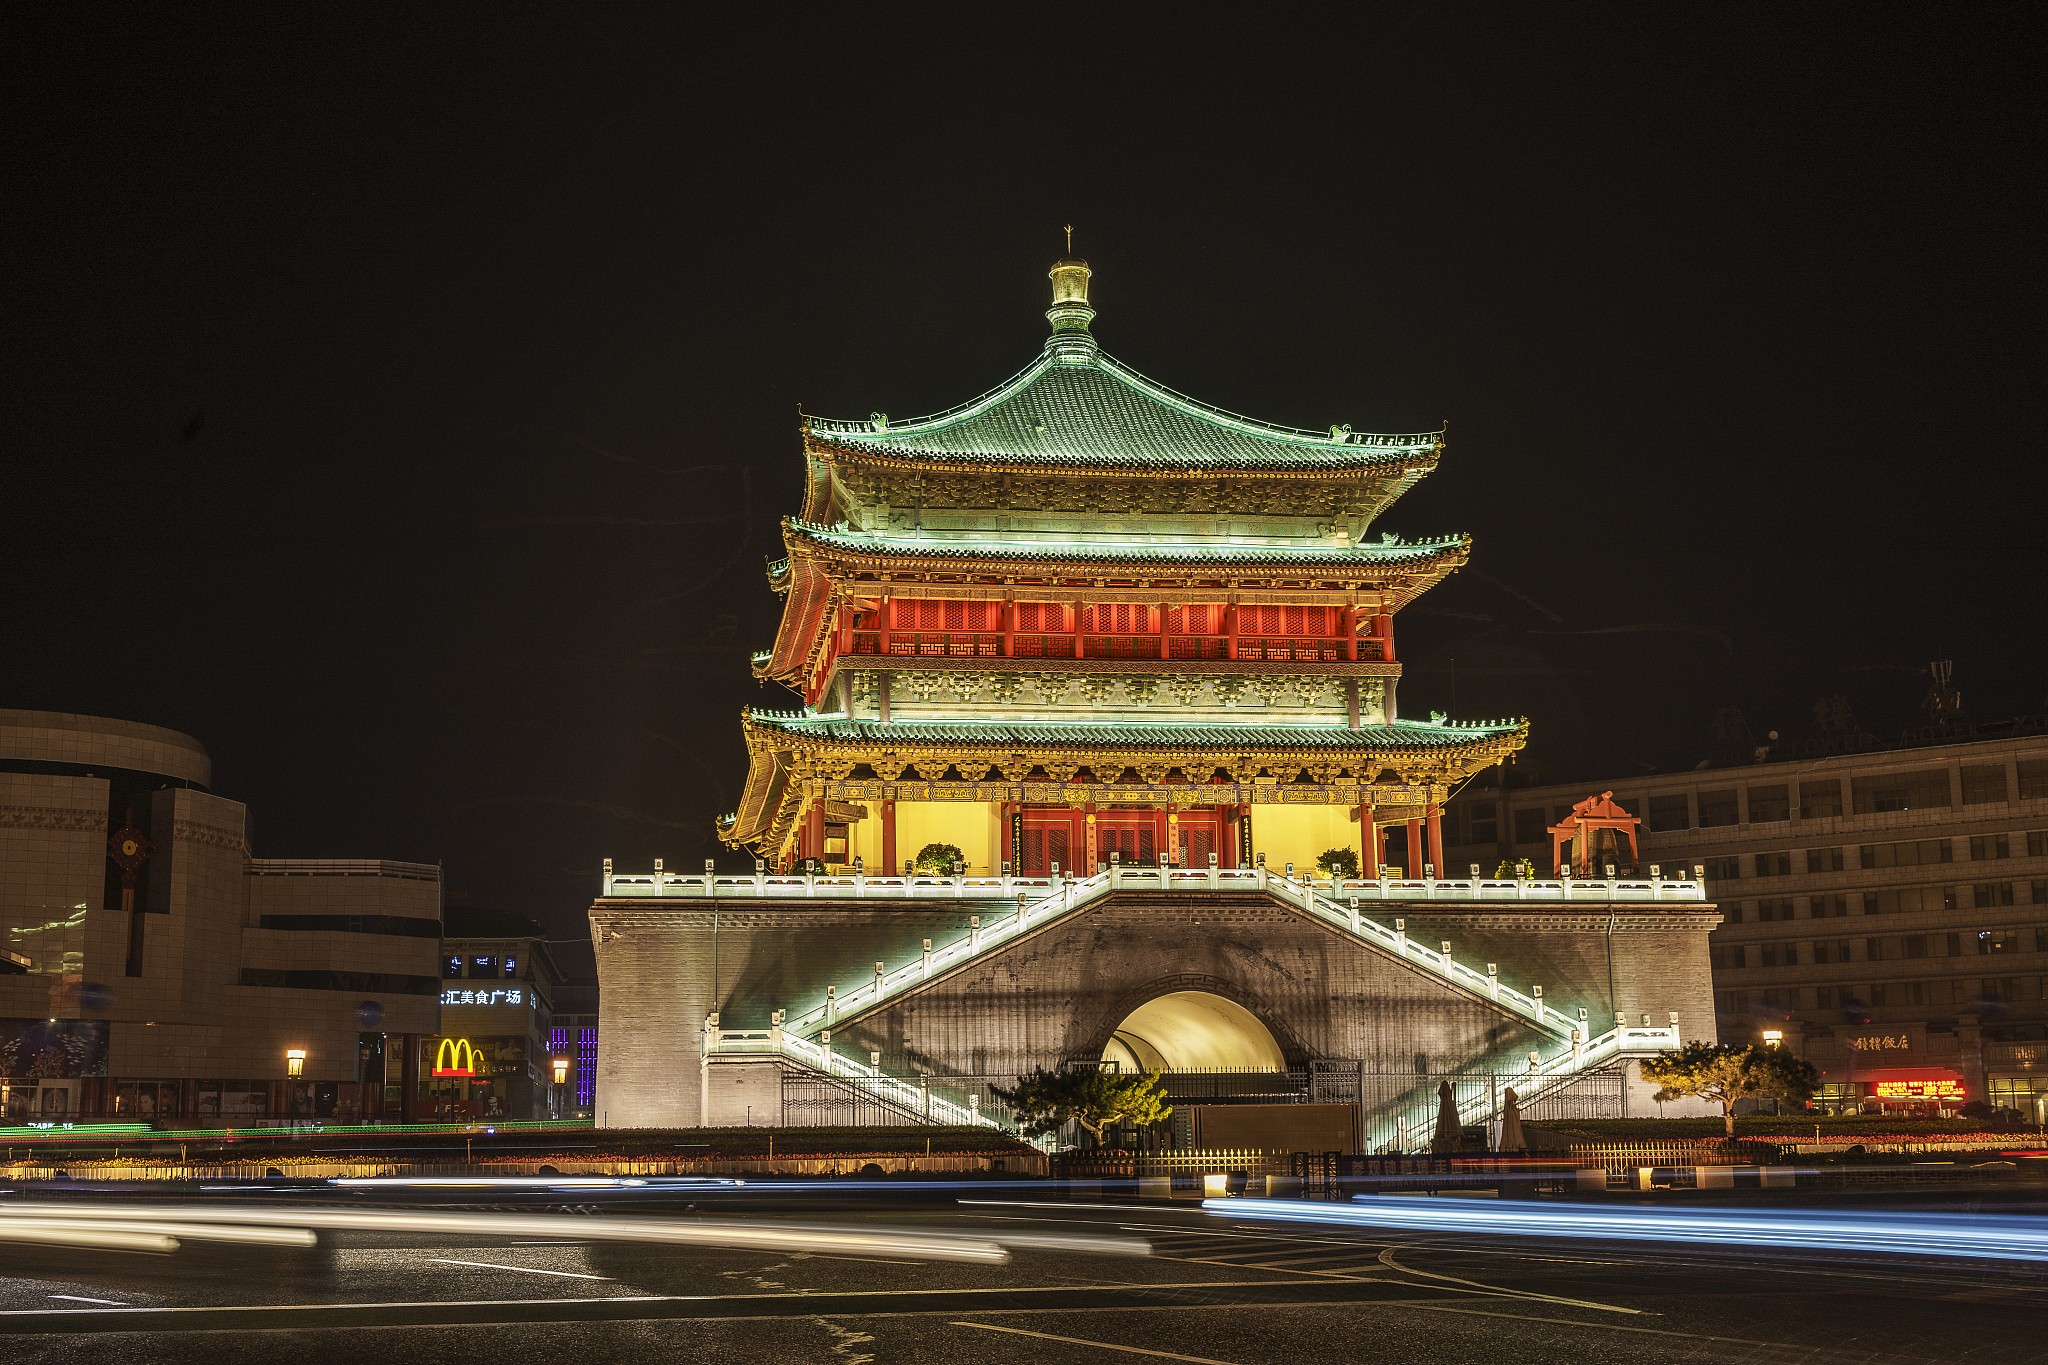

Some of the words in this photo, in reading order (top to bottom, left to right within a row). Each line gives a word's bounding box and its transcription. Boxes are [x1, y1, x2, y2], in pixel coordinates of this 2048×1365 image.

[440, 989, 521, 1005] 汇美食广场
[1380, 1179, 1414, 1187] SUBWAY
[1449, 1178, 1463, 1186] THE
[1464, 1177, 1482, 1185] BELL
